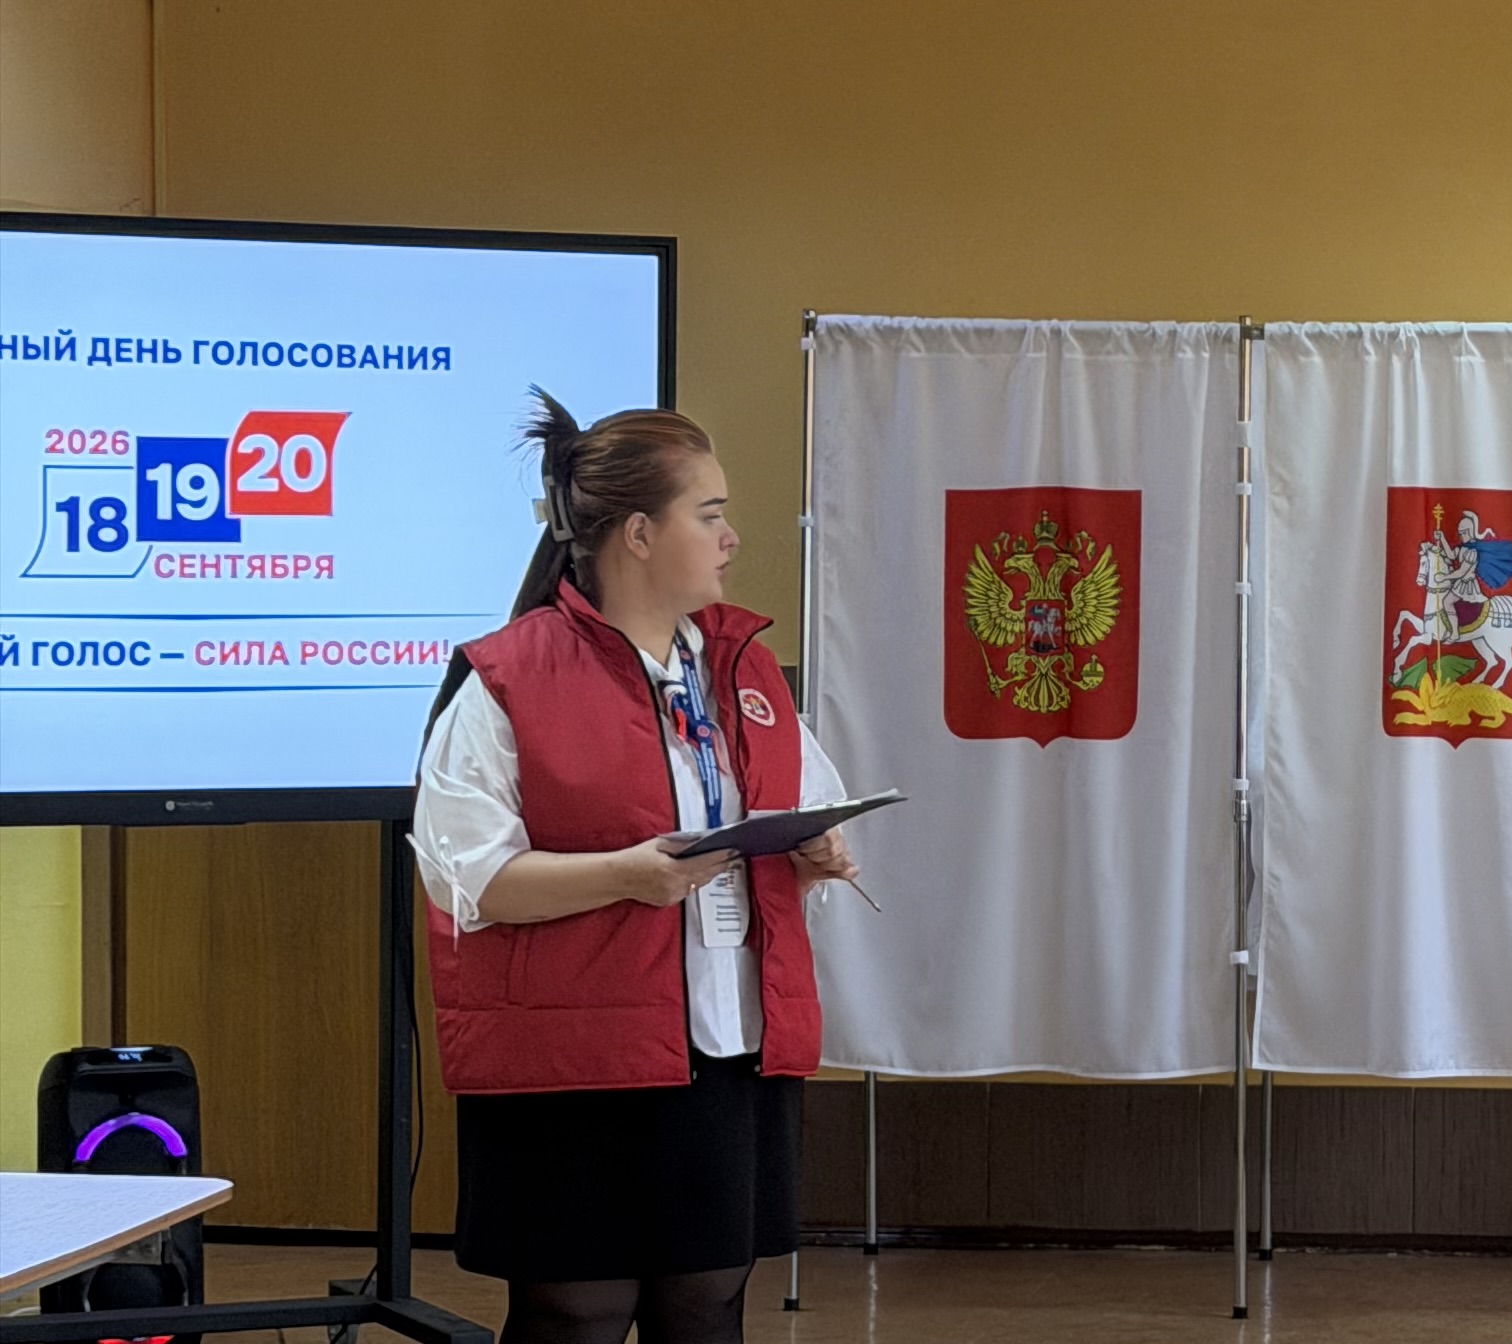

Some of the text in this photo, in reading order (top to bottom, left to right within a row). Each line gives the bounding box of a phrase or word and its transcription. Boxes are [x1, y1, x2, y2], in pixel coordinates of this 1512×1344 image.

[0, 328, 451, 370] НЫЙ ДЕНЬ ГОЛОСОВАНИЯ
[45, 428, 130, 455] 2026
[55, 434, 327, 553] 18 19 20
[153, 553, 335, 580] СЕНТЯБРЯ
[31, 640, 151, 667] ГОЛОС
[194, 640, 290, 666] СИЛА
[300, 639, 449, 666] РОССИИ!
